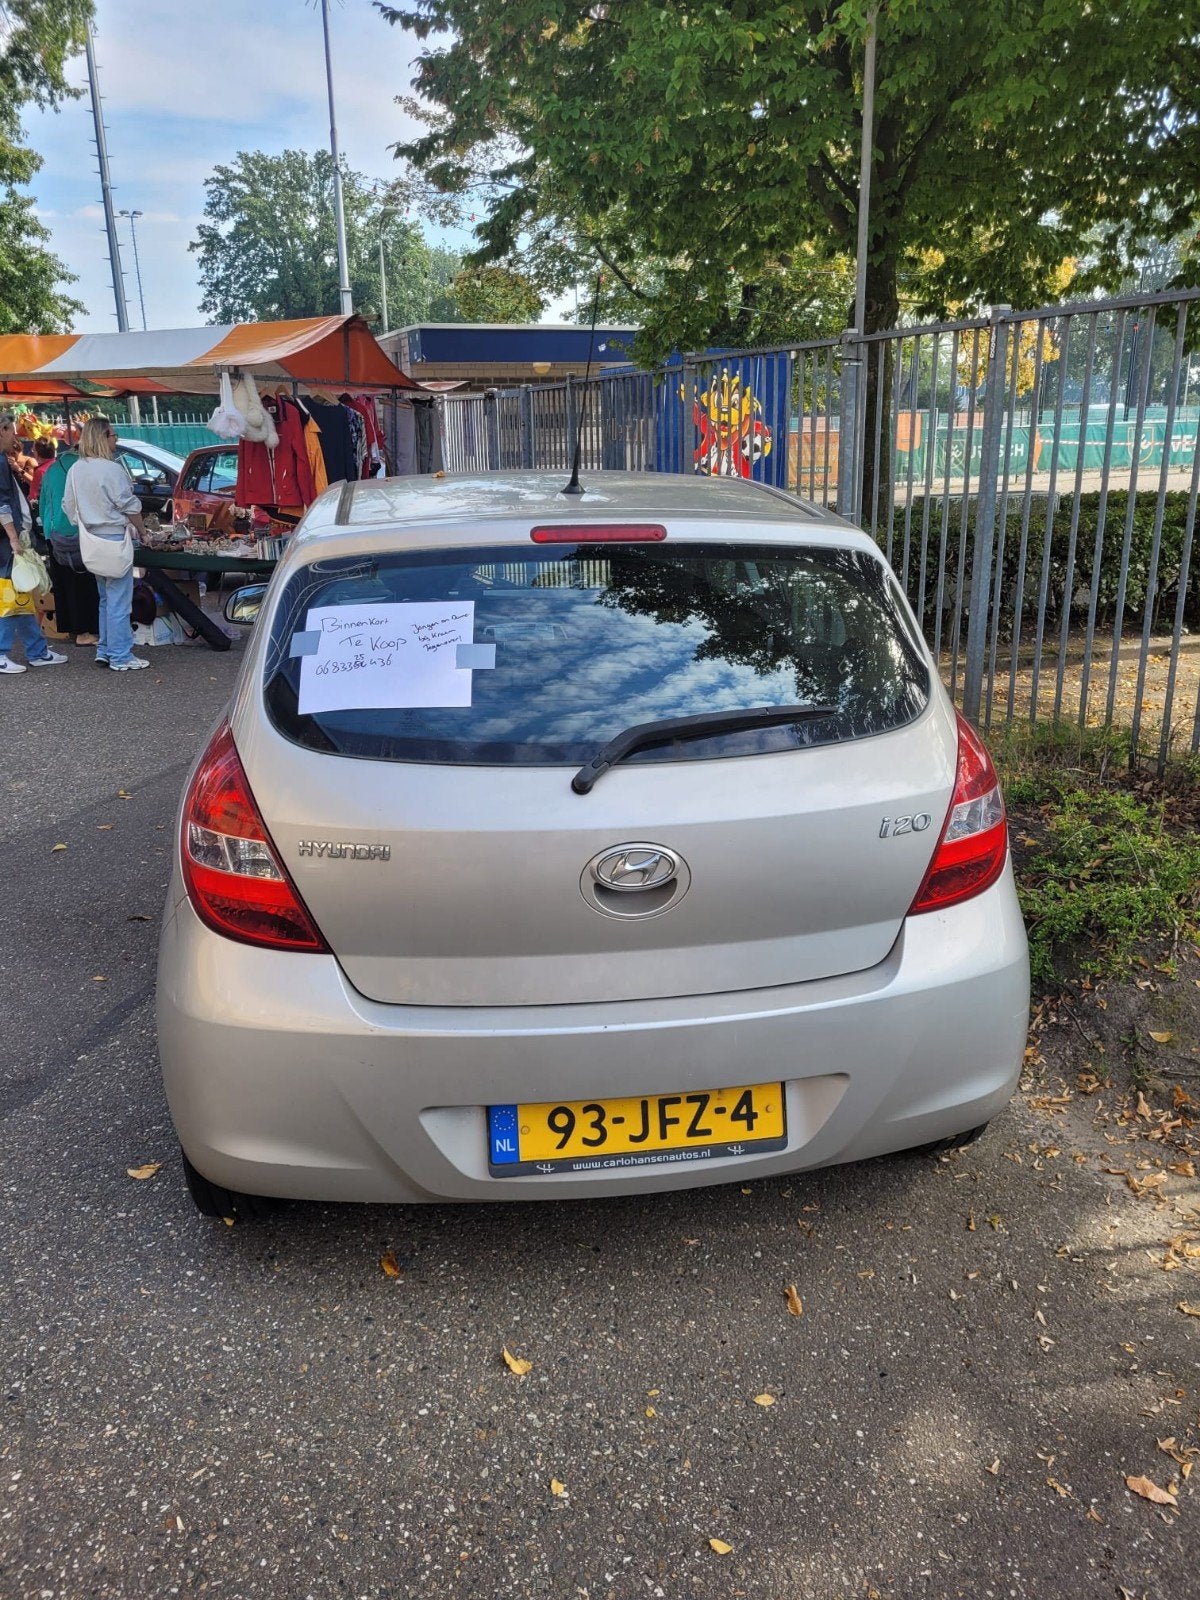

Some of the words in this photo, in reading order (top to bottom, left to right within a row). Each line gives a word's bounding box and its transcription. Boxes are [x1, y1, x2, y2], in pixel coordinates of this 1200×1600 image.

[339, 633, 363, 648] Te
[370, 636, 407, 651] Koop
[879, 812, 932, 838] i20
[298, 840, 391, 861] HYUNDAI
[547, 1089, 759, 1150] 93-JFZ-4
[495, 1139, 516, 1153] NL
[572, 1149, 711, 1171] www.carlohansenautos.nl
